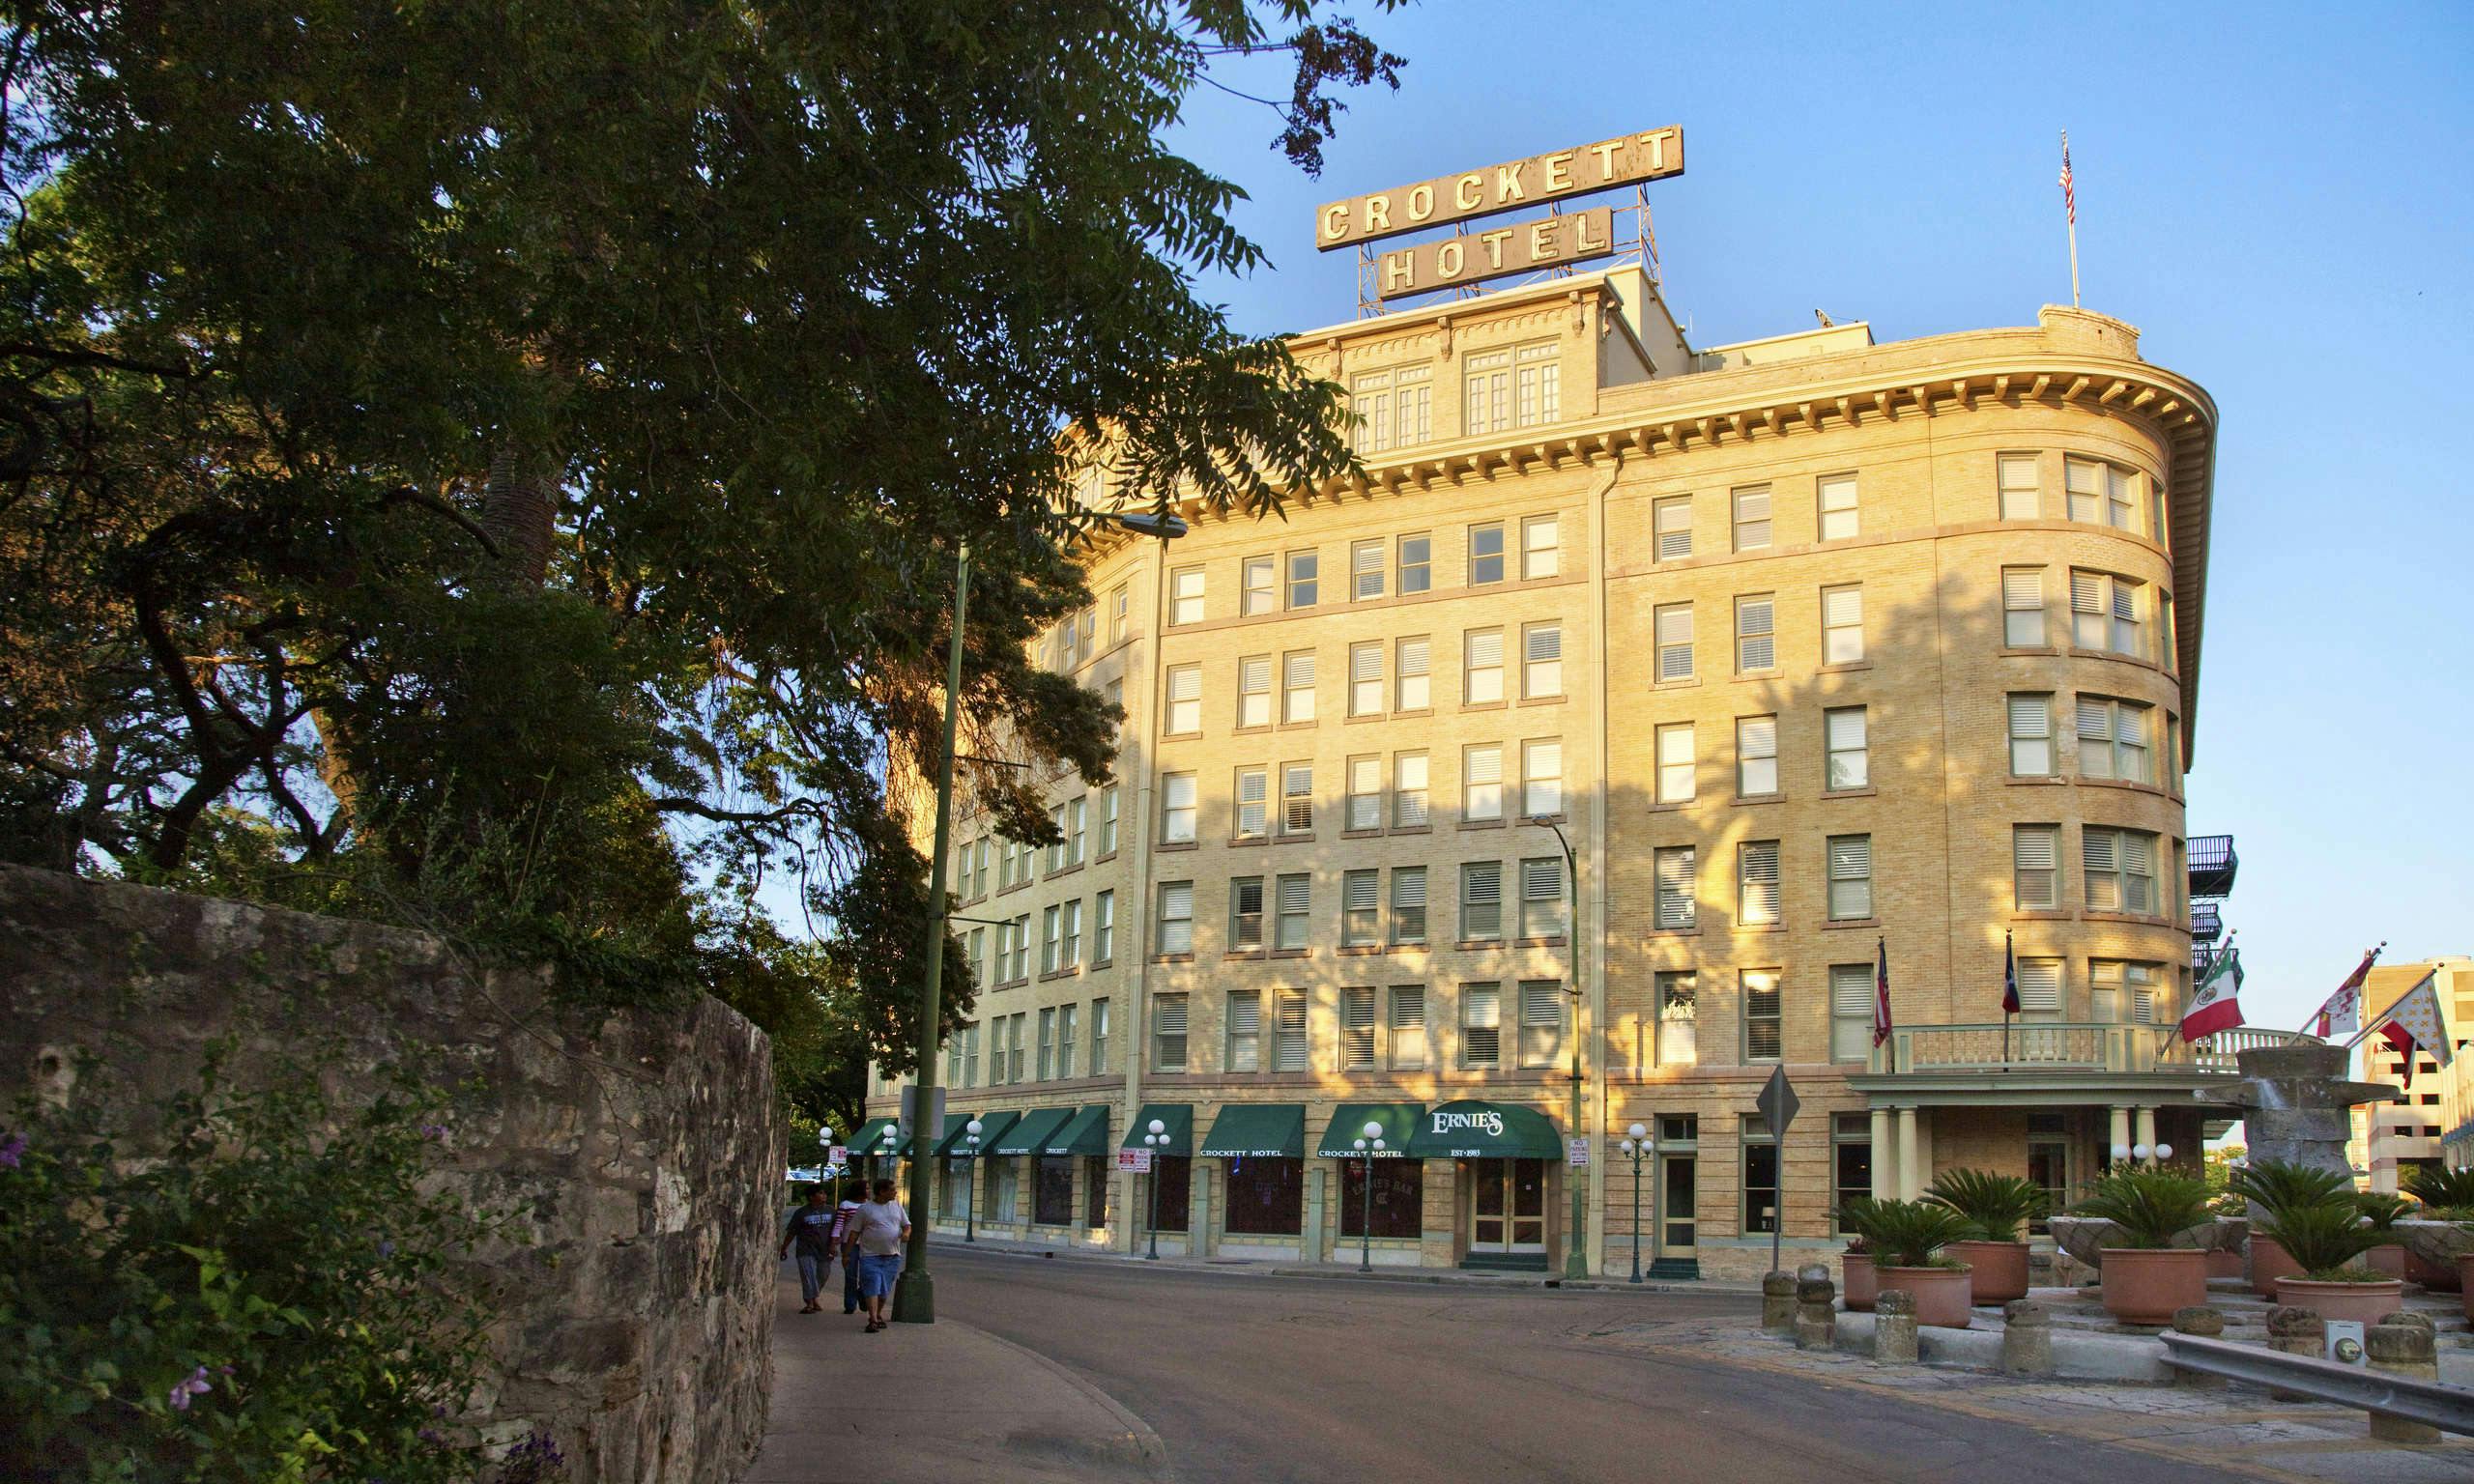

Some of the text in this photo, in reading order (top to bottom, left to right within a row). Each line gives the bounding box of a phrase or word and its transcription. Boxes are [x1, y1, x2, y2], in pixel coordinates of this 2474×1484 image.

[1323, 128, 1674, 241] CROCKETT
[1387, 214, 1606, 291] HOTEL
[1431, 1110, 1504, 1136] ERNIE'S
